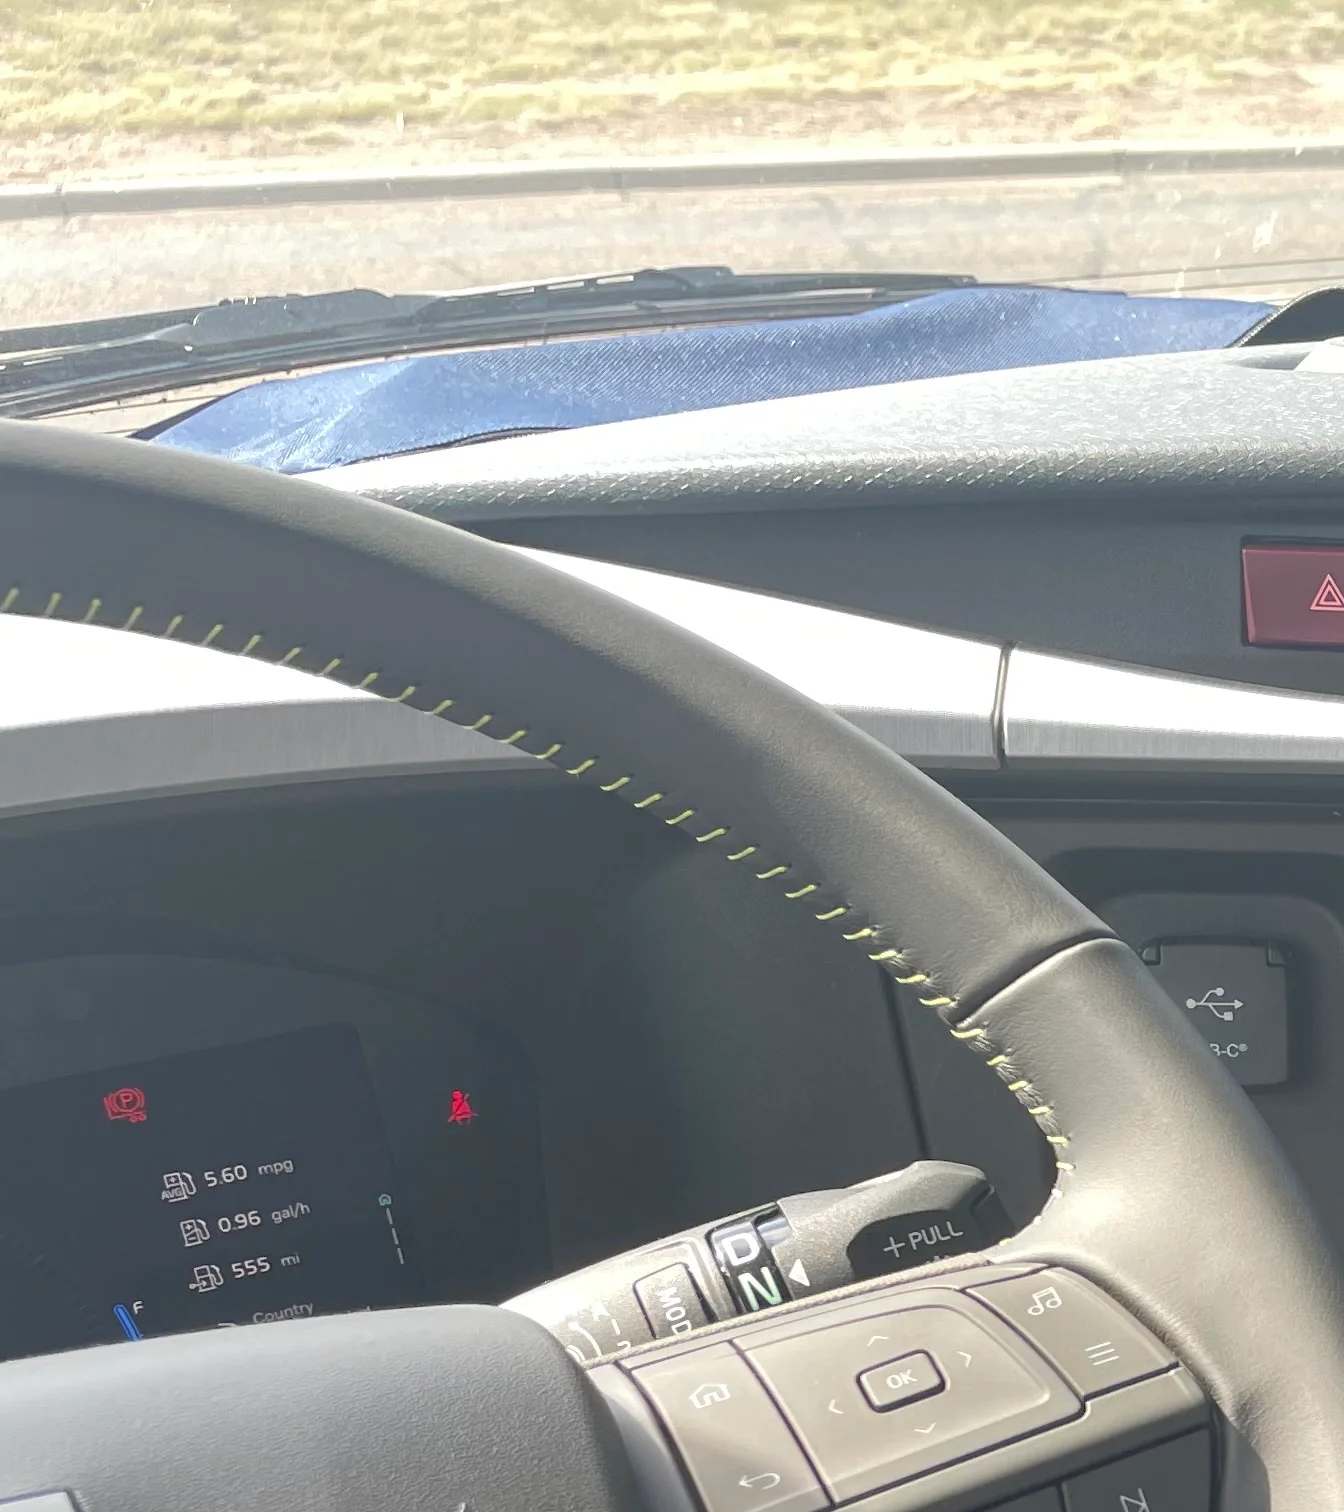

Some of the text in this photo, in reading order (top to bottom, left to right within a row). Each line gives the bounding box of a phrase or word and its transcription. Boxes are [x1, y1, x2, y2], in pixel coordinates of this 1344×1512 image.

[204, 1159, 294, 1188] 5.60 mpg
[217, 1202, 311, 1233] 0.96 gal/h
[721, 1232, 760, 1266] D
[907, 1221, 964, 1251] PULL
[231, 1252, 301, 1279] 555 mi
[737, 1266, 783, 1311] N
[132, 1300, 144, 1315] F
[252, 1303, 314, 1324] Country
[657, 1286, 693, 1338] MOD
[886, 1369, 918, 1389] OK
